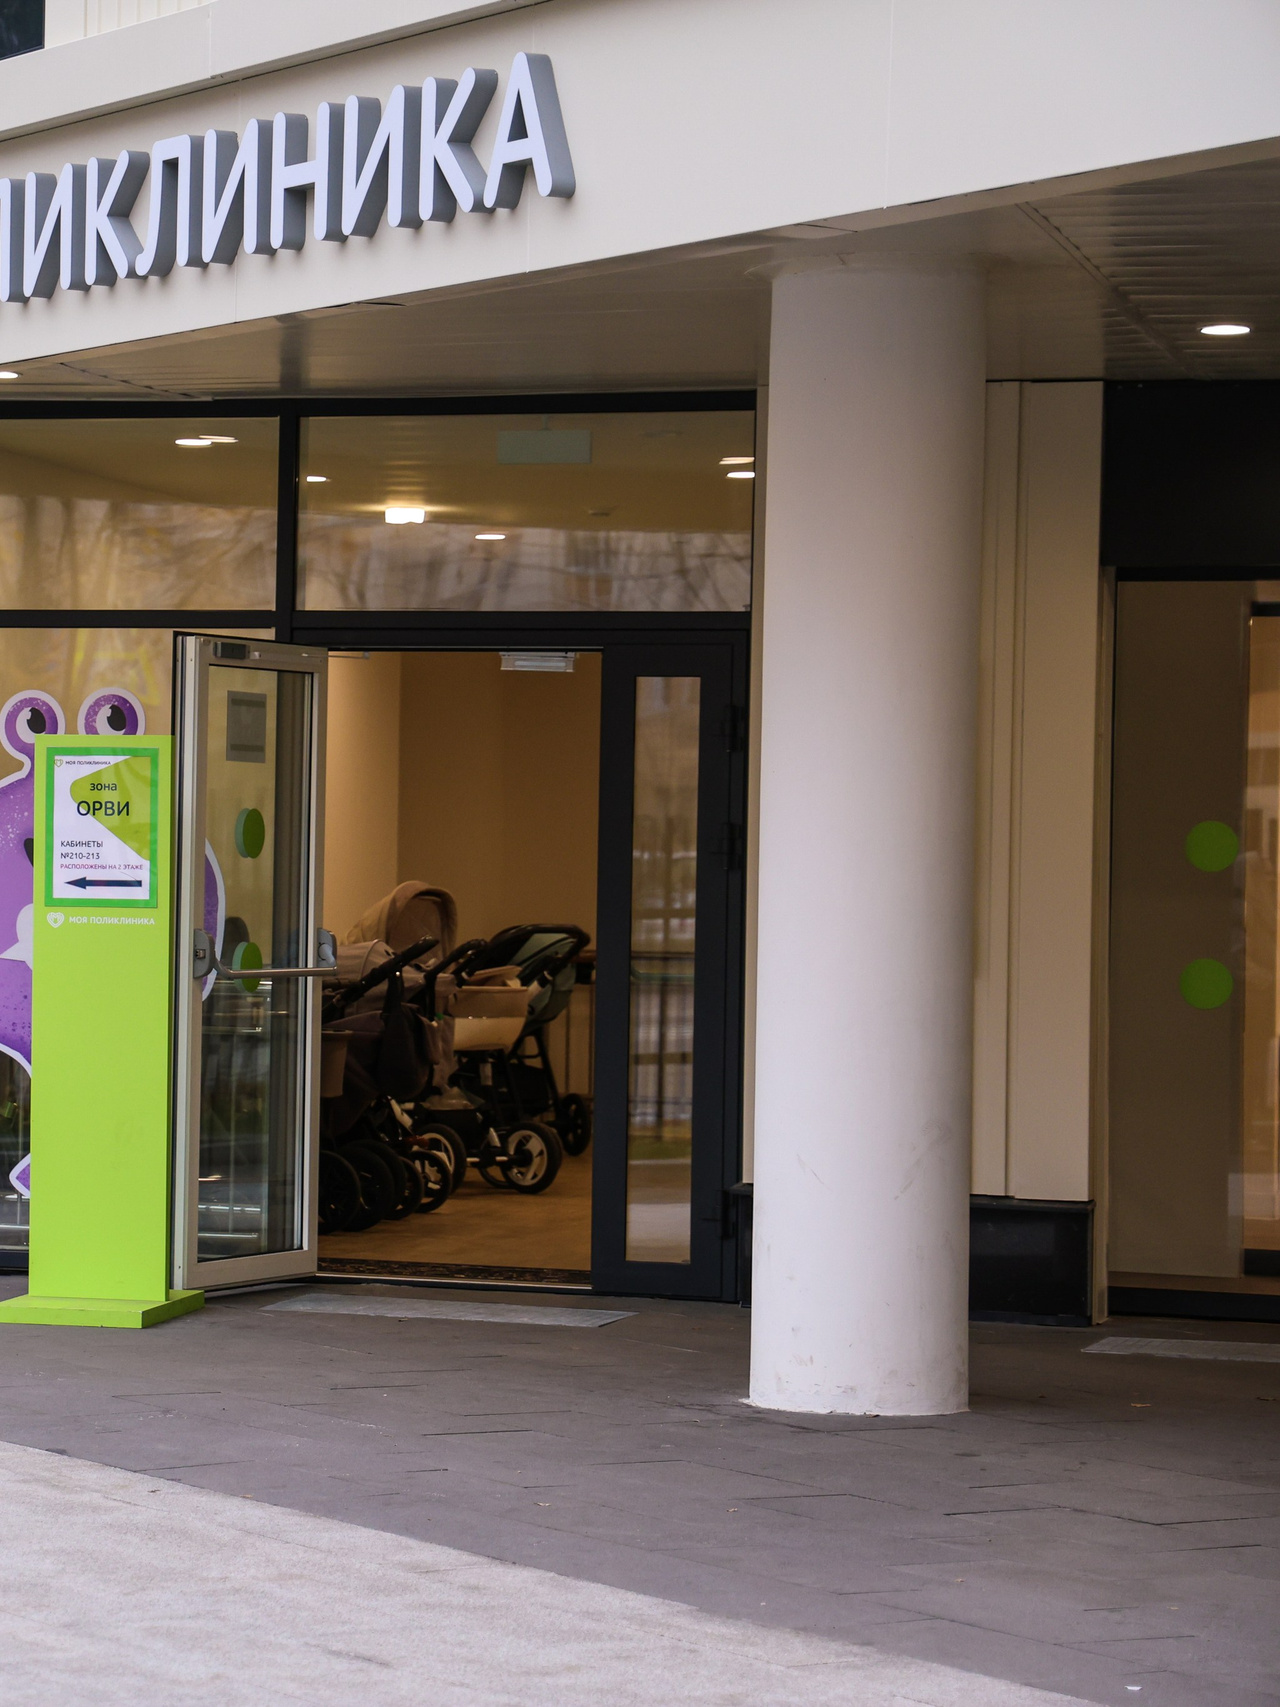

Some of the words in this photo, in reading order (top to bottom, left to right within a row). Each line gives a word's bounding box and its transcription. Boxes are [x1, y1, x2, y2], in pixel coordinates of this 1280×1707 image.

[90, 783, 117, 791] зона
[76, 800, 130, 816] ОРВИ
[69, 916, 88, 924] МОЯ
[90, 916, 155, 925] ПОЛИКЛИНИКА
